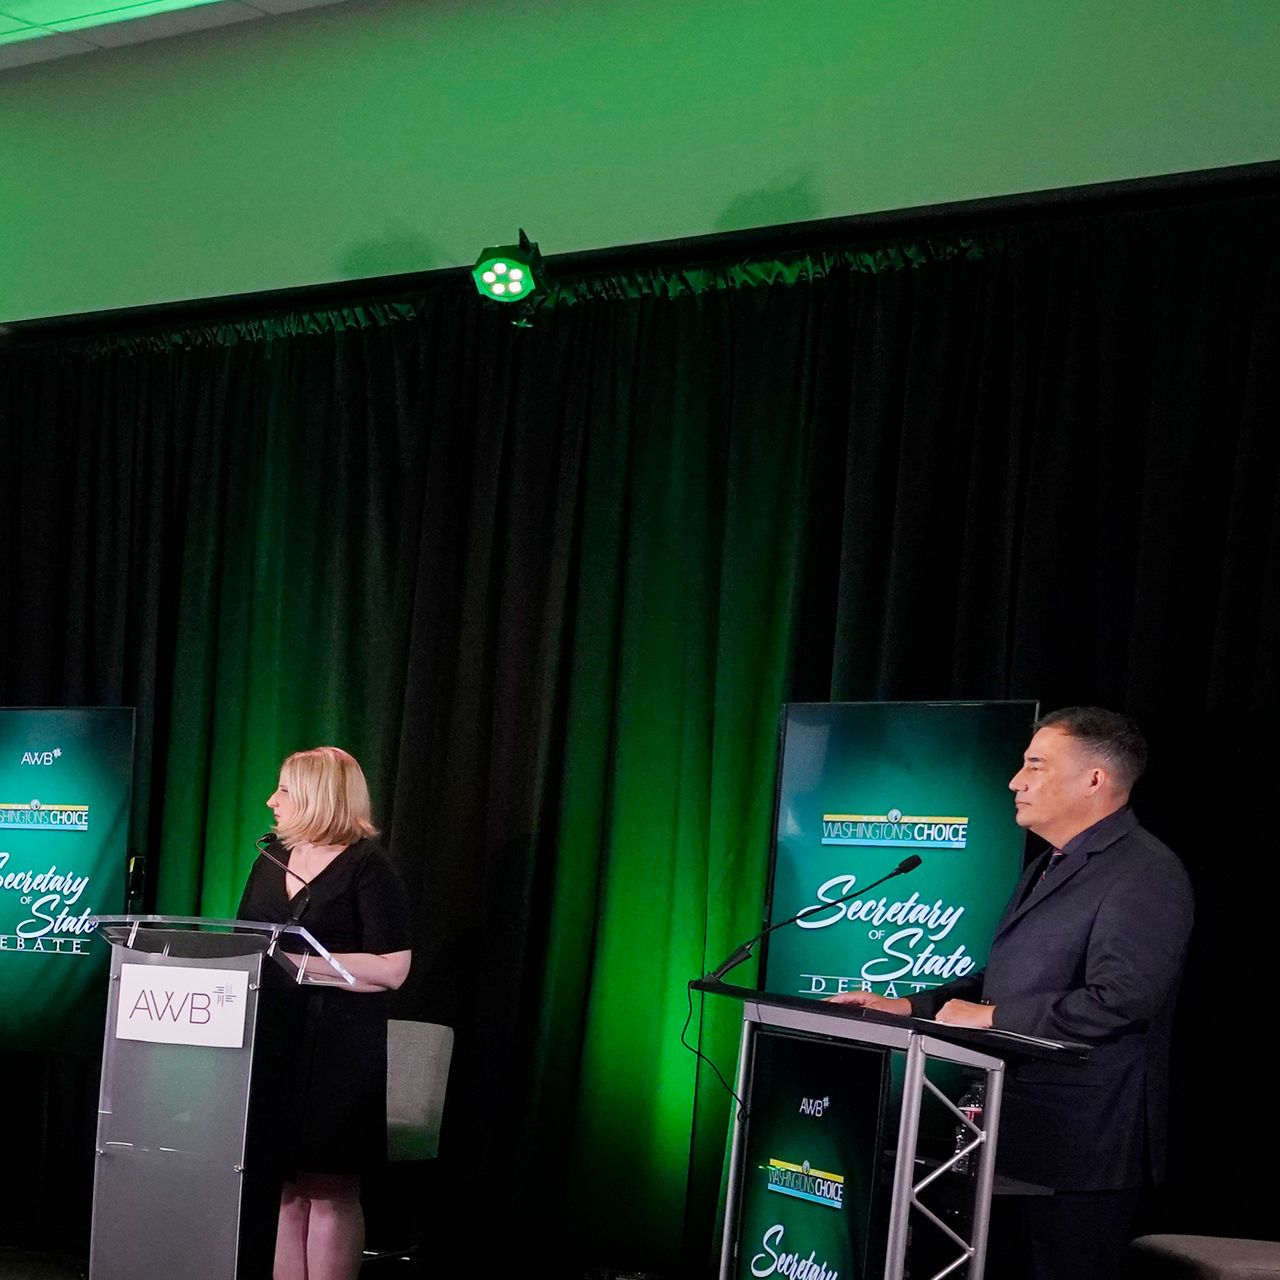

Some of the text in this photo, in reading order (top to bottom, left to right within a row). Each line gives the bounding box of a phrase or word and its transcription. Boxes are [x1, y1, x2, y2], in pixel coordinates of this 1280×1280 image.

[20, 751, 53, 766] AWB
[50, 811, 89, 825] CHOICE
[822, 822, 967, 841] WASHINGTON'S CHOICE
[20, 896, 33, 905] OF
[796, 875, 965, 941] Secretary
[16, 894, 98, 938] State
[868, 930, 885, 939] OF
[861, 927, 976, 982] State
[811, 977, 926, 998] DEBAT
[129, 989, 211, 1024] AWB
[799, 1097, 823, 1117] AWB
[815, 1178, 844, 1202] CHOICE
